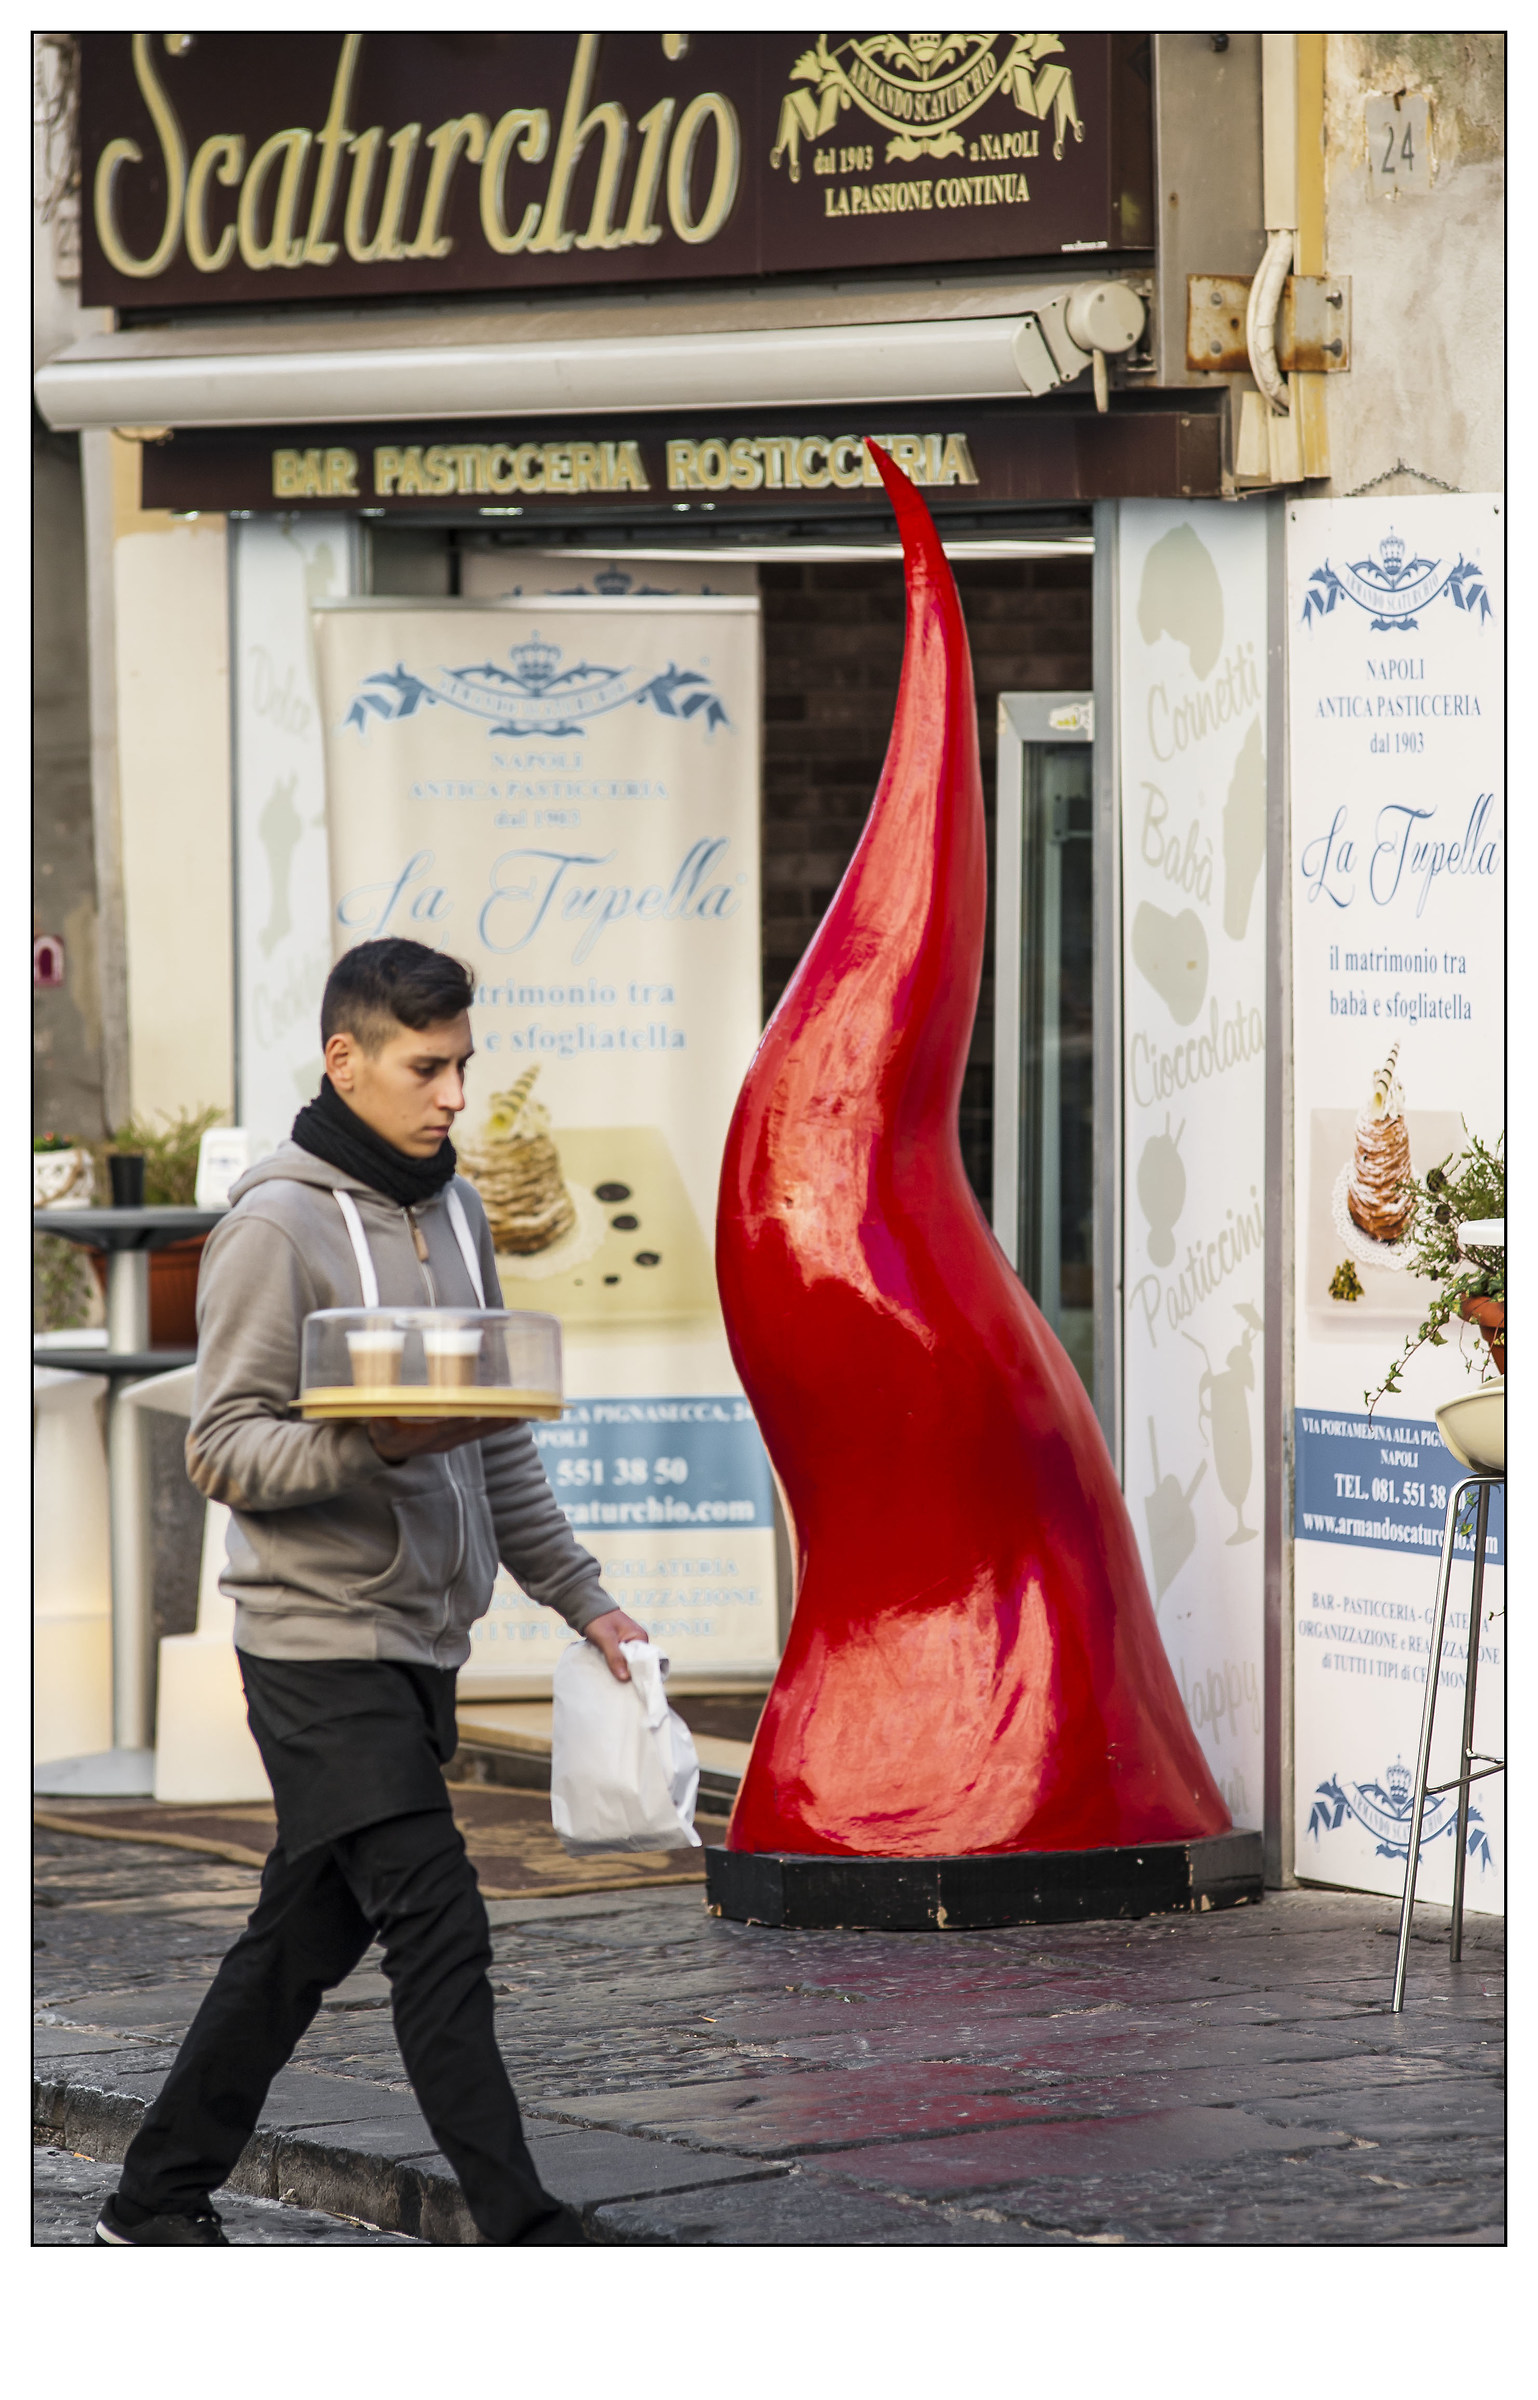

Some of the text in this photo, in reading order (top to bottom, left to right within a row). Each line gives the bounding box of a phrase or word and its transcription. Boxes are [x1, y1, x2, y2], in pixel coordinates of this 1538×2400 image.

[93, 34, 742, 278] Scaturchio
[813, 145, 874, 175] dal 1903
[980, 130, 1039, 162] NAPOLI
[1380, 122, 1414, 173] 24
[824, 173, 1030, 217] LA PASSIONE CONTINUA
[272, 433, 980, 497] BAR PASTICCERIA ROSTICCERIA
[1367, 658, 1424, 680] NAPOLI
[1147, 640, 1260, 763] Cornetti
[1316, 694, 1481, 718] ANTICA PASTICCERIA
[1370, 732, 1424, 753] dal 1903
[491, 752, 583, 772] NAPOLI
[409, 778, 669, 800] ANTICA PASTICCERIA
[1139, 780, 1213, 907] Babà
[1301, 804, 1357, 908] La
[1330, 945, 1467, 974] il matrimonio tra
[473, 977, 676, 1006] trimonio tra
[1330, 990, 1472, 1026] babà e sfogliatella
[511, 1022, 687, 1058] sfogliatella
[1131, 995, 1265, 1108] Cioccolata
[1129, 1184, 1265, 1348] Pasticcini
[533, 1428, 588, 1450] APOLI
[1302, 1417, 1320, 1434] VIA
[1392, 1427, 1420, 1445] ALLA
[556, 1456, 689, 1487] 551 38 50
[1380, 1449, 1419, 1468] NAPOLI
[1334, 1473, 1369, 1500] TEL.
[1371, 1477, 1400, 1504] 081.
[1403, 1481, 1426, 1507] 551
[1429, 1484, 1447, 1510] 38
[1303, 1513, 1499, 1555] www.armandoscaturcio.cm
[1312, 1591, 1335, 1610] BAR
[1343, 1596, 1416, 1622] PASTICCERIA
[1298, 1619, 1398, 1650] ORGANIZZAZIONE
[1322, 1653, 1332, 1669] di
[1333, 1653, 1366, 1675] TUTTI
[1376, 1660, 1398, 1679] TIPI
[1401, 1664, 1410, 1681] di
